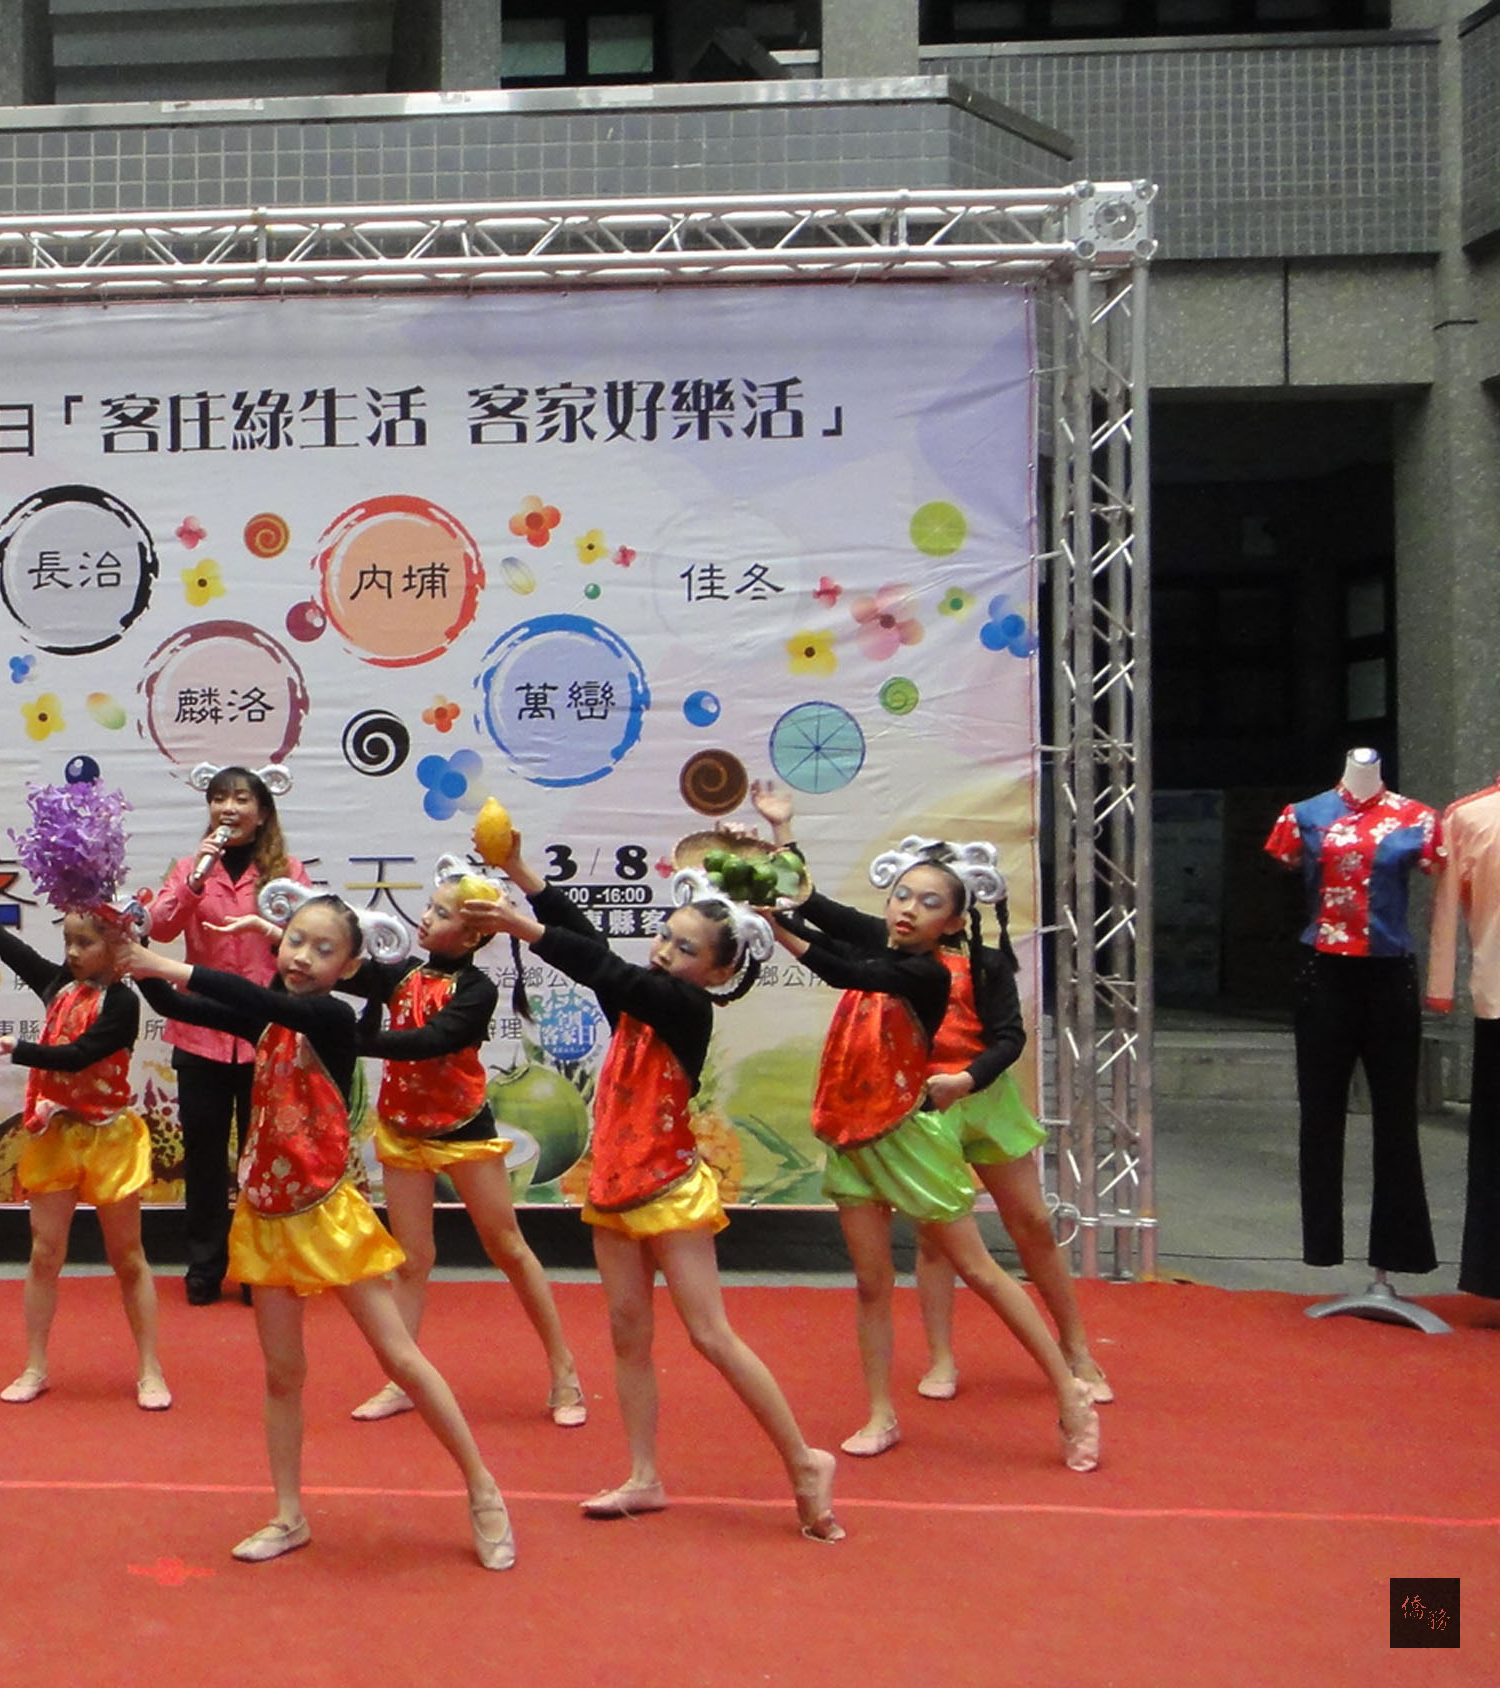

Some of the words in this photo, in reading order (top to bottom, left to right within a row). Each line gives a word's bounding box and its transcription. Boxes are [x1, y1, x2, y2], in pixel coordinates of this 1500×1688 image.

[467, 376, 844, 446] 客家好樂活」
[26, 549, 123, 591] 長治
[679, 562, 785, 603] 佳冬
[173, 685, 276, 726] 麟洛
[514, 679, 617, 722] 萬巒
